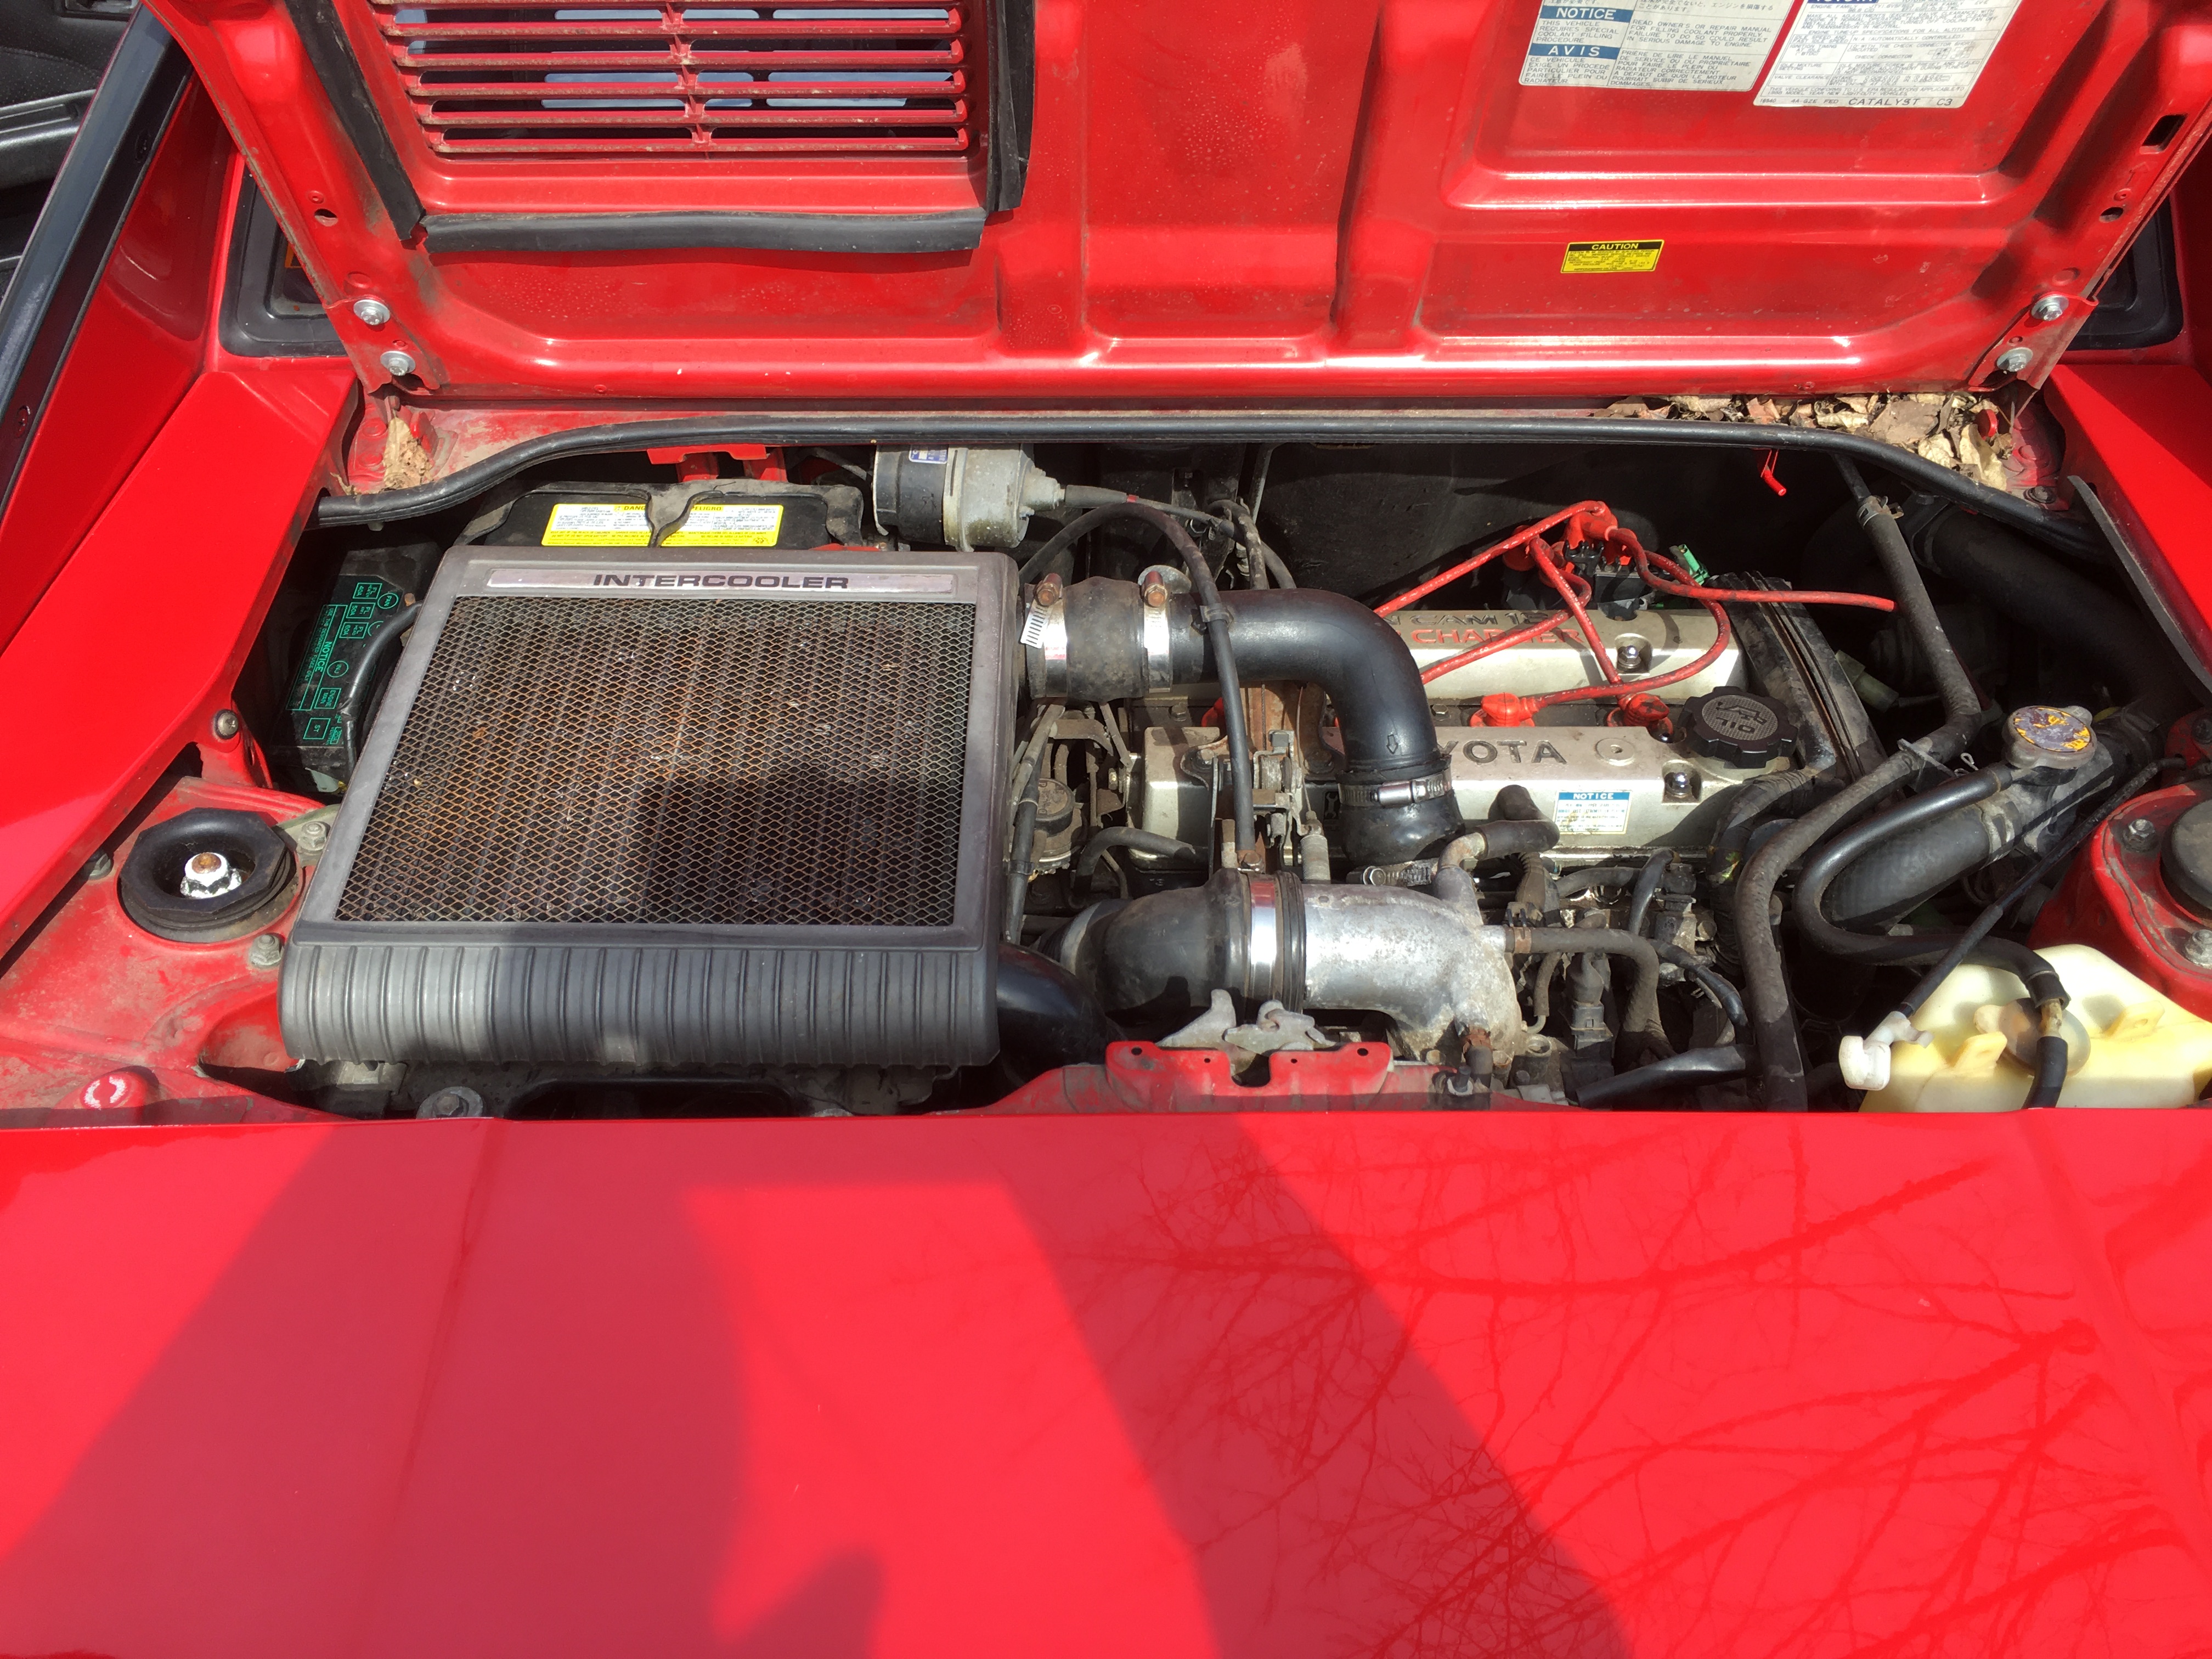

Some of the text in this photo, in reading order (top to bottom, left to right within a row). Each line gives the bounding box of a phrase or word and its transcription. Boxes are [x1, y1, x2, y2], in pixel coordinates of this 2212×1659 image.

[1556, 8, 1616, 20] NOTICE
[1548, 46, 1600, 57] AVIS
[1848, 98, 1921, 106] CATALYST
[592, 574, 849, 589] INTERCOOLER
[384, 595, 392, 606] FAN
[349, 605, 358, 616] 50A
[1409, 614, 1498, 625] CAM
[342, 624, 351, 635] 60A
[315, 641, 332, 672] NOTICE
[334, 664, 342, 674] INJ
[320, 693, 328, 704] MAIN
[325, 690, 336, 707] ENGINE
[1716, 716, 1756, 733] OIL
